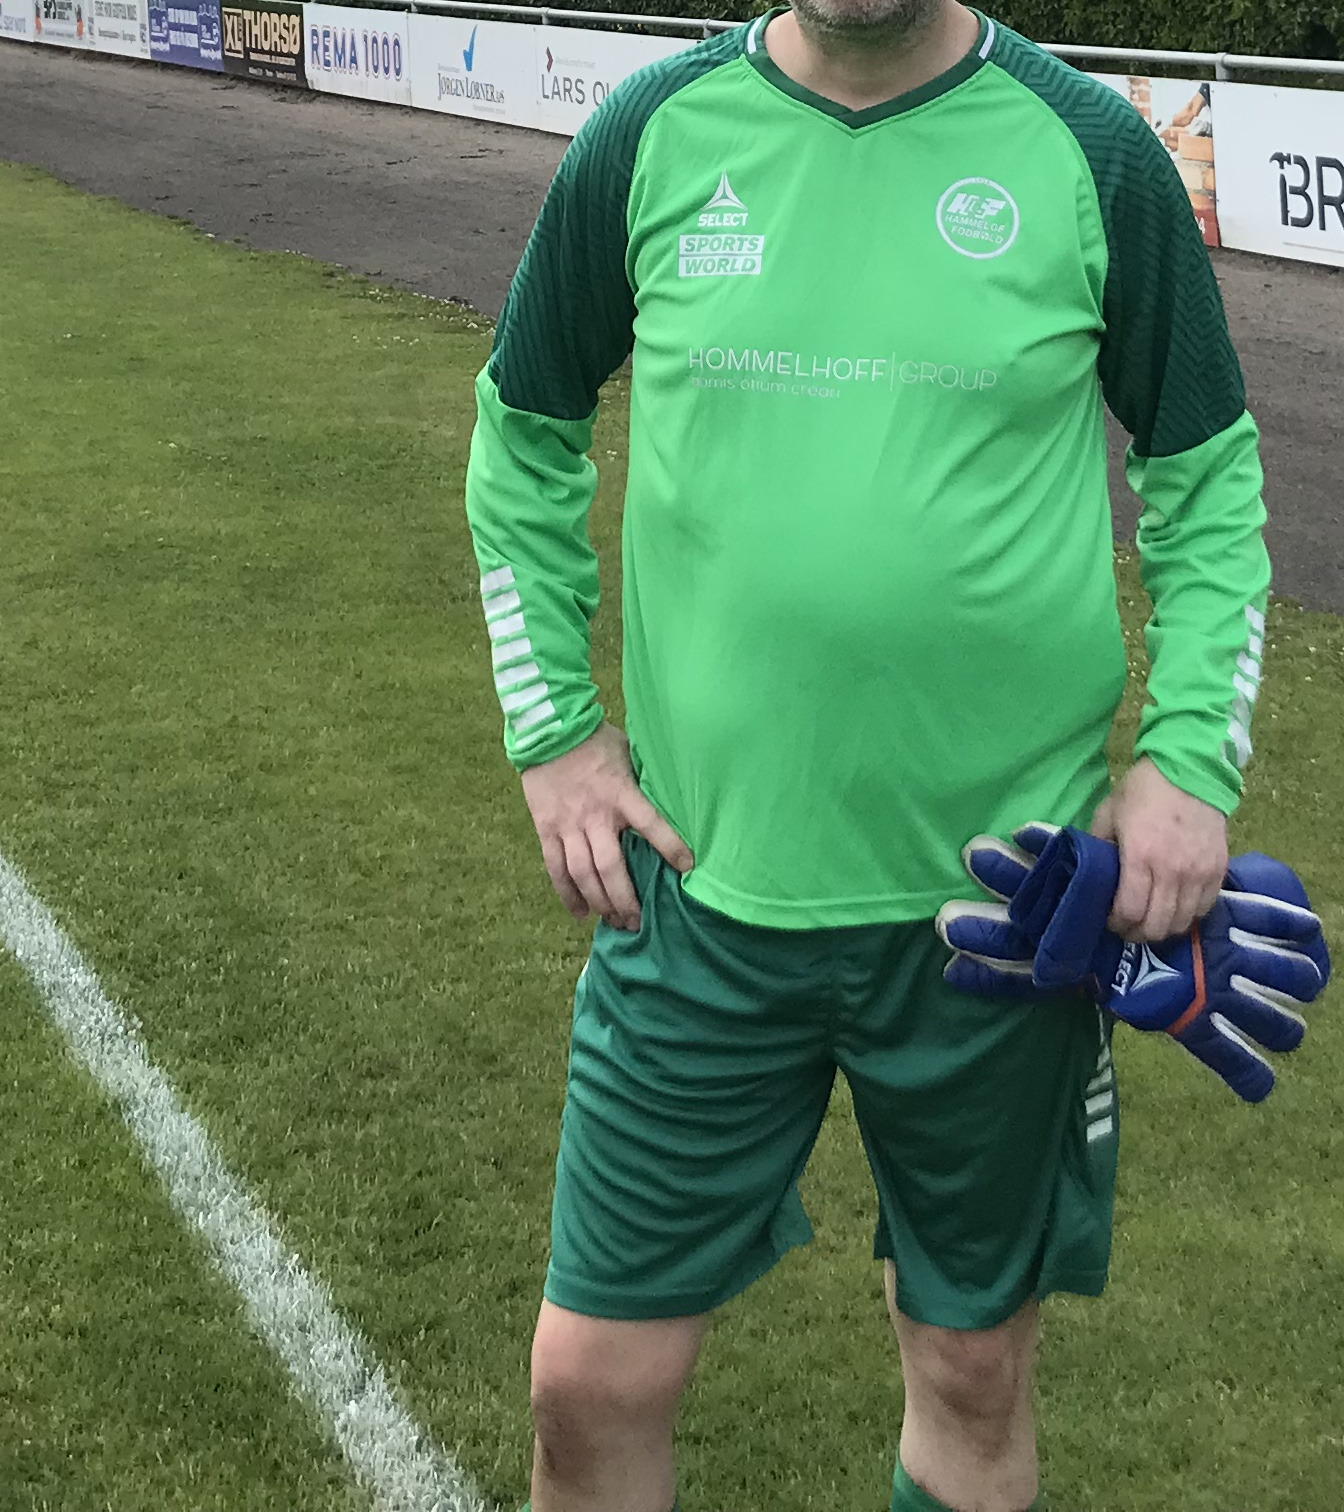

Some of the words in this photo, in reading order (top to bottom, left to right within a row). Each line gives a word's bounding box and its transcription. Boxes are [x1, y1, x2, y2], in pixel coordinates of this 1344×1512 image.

[243, 10, 301, 54] THORSØ
[310, 24, 359, 75] REMA
[362, 29, 403, 82] 1000
[541, 74, 586, 105] LARS
[697, 212, 748, 227] SELECT
[684, 236, 760, 253] SPORTS
[684, 257, 756, 274] WORLD
[688, 346, 887, 382] HOMMELHOFF
[898, 360, 999, 392] GROUP
[1111, 941, 1136, 997] ELECT
